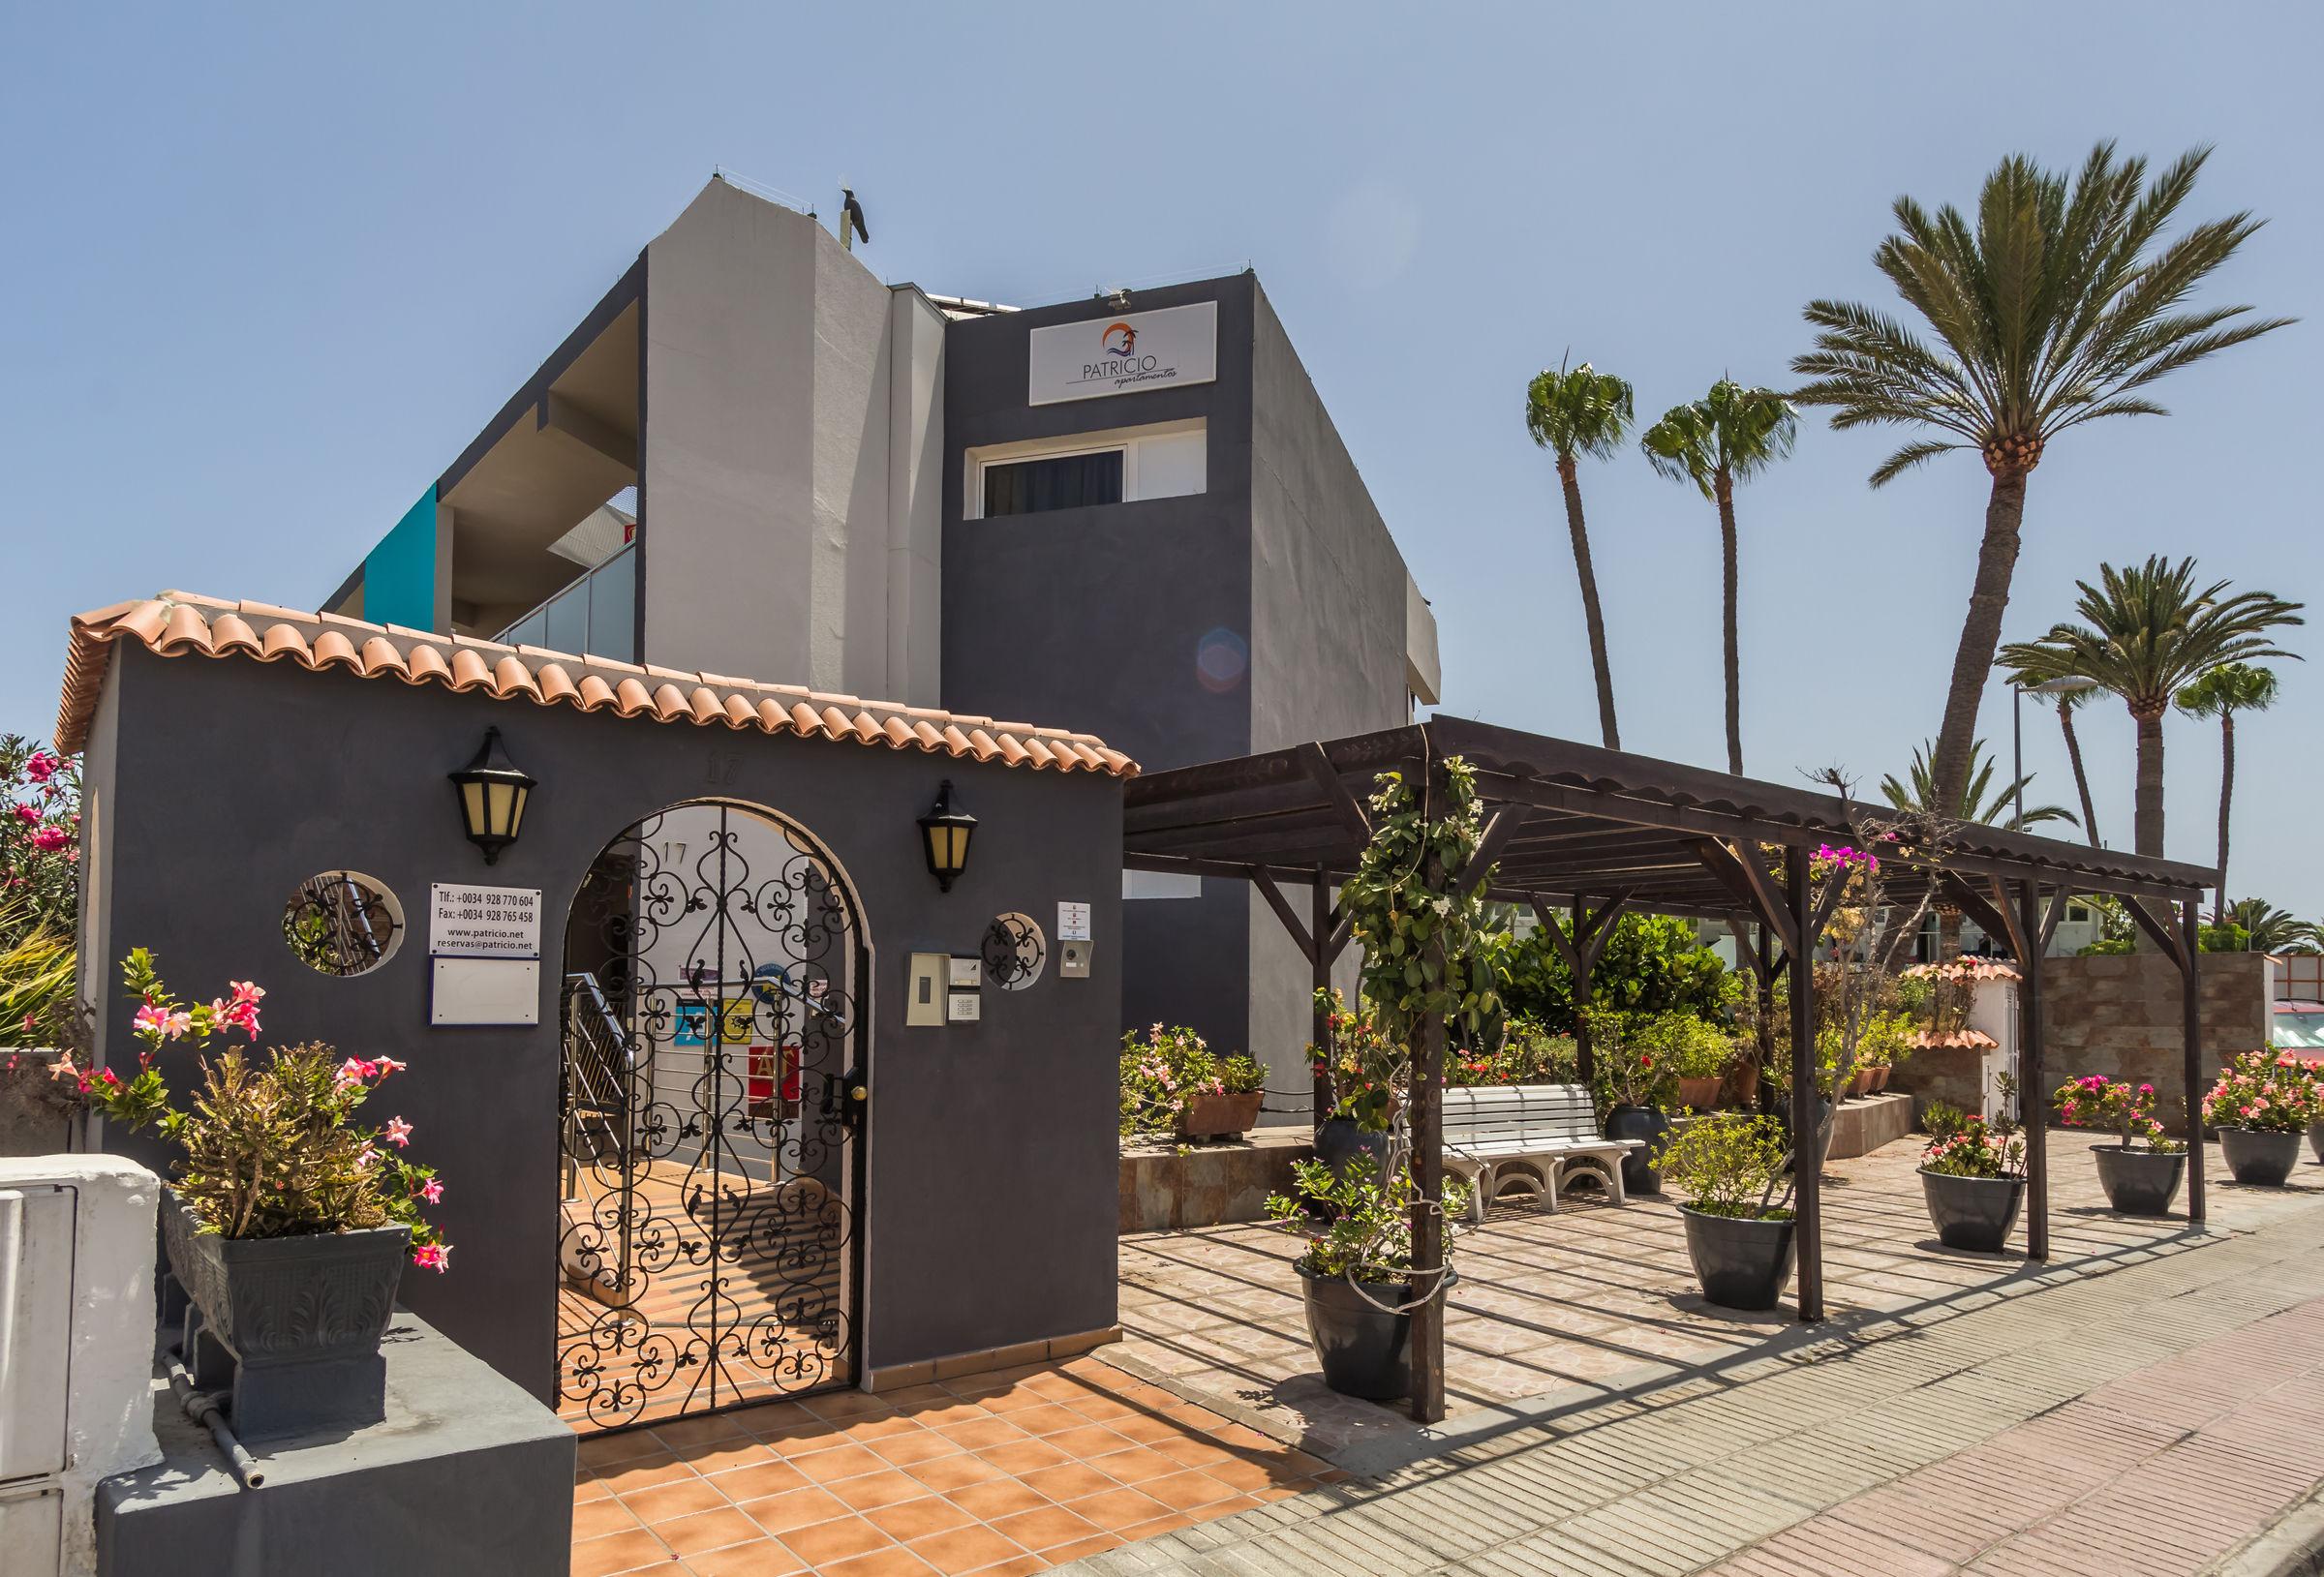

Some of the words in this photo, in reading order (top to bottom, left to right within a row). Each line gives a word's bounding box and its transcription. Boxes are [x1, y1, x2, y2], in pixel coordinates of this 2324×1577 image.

[1083, 355, 1157, 379] PATRICIO
[1114, 368, 1177, 389] apartamentos
[706, 752, 744, 785] 17
[663, 841, 687, 864] 17
[439, 891, 455, 902] Tlf.:
[457, 893, 482, 904] +0034
[486, 894, 501, 905] 928
[503, 895, 517, 906] 770
[519, 895, 534, 907] 604
[439, 908, 455, 920] Fax:
[457, 909, 483, 921] +0034
[486, 910, 501, 922] 928
[503, 911, 517, 922] 765
[518, 912, 534, 923] 458
[447, 929, 524, 938] www.patricio.net
[437, 940, 533, 950] reservas@patricio.net
